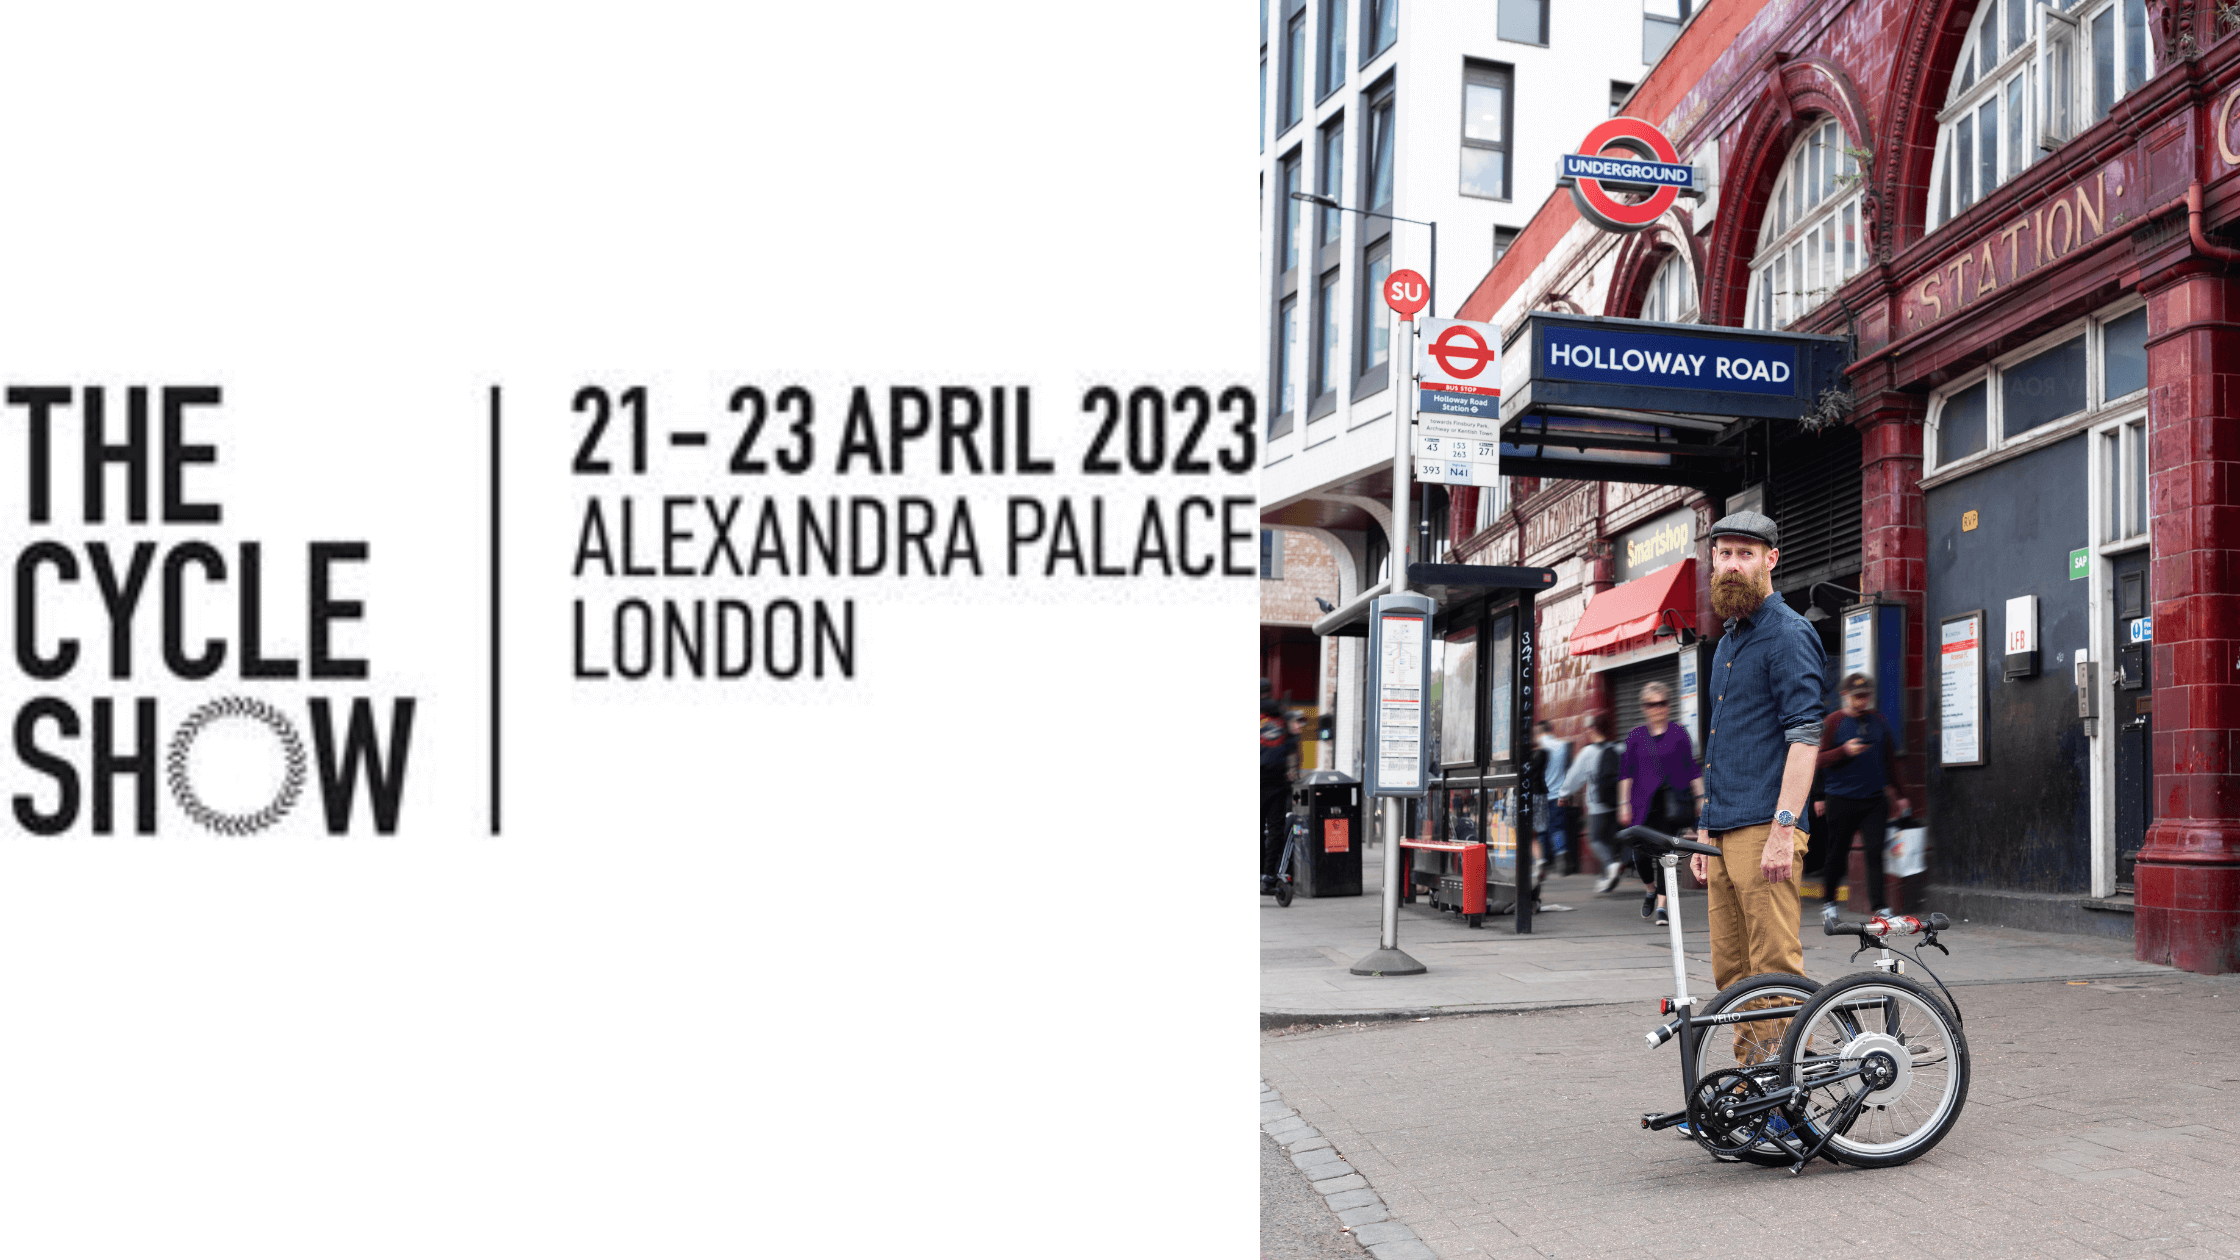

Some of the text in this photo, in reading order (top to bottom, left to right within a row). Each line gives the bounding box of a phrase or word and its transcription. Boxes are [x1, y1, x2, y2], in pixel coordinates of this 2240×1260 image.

[1568, 158, 1688, 183] UNDERGROUND
[1919, 171, 2105, 319] STATION
[1391, 281, 1422, 302] SU
[1551, 342, 1790, 383] HOLLOWAY ROAD
[1433, 394, 1488, 406] Holloway Road
[1442, 403, 1469, 413] Station
[1427, 443, 1438, 452] 43
[1479, 447, 1494, 456] 271
[1453, 450, 1466, 458] 263
[1423, 466, 1440, 475] 393
[1450, 468, 1468, 477] N41
[1627, 522, 1688, 568] Smartshop
[2075, 555, 2087, 569] SAP
[2010, 630, 2025, 650] LFB
[1711, 1012, 1741, 1024] VELLO
